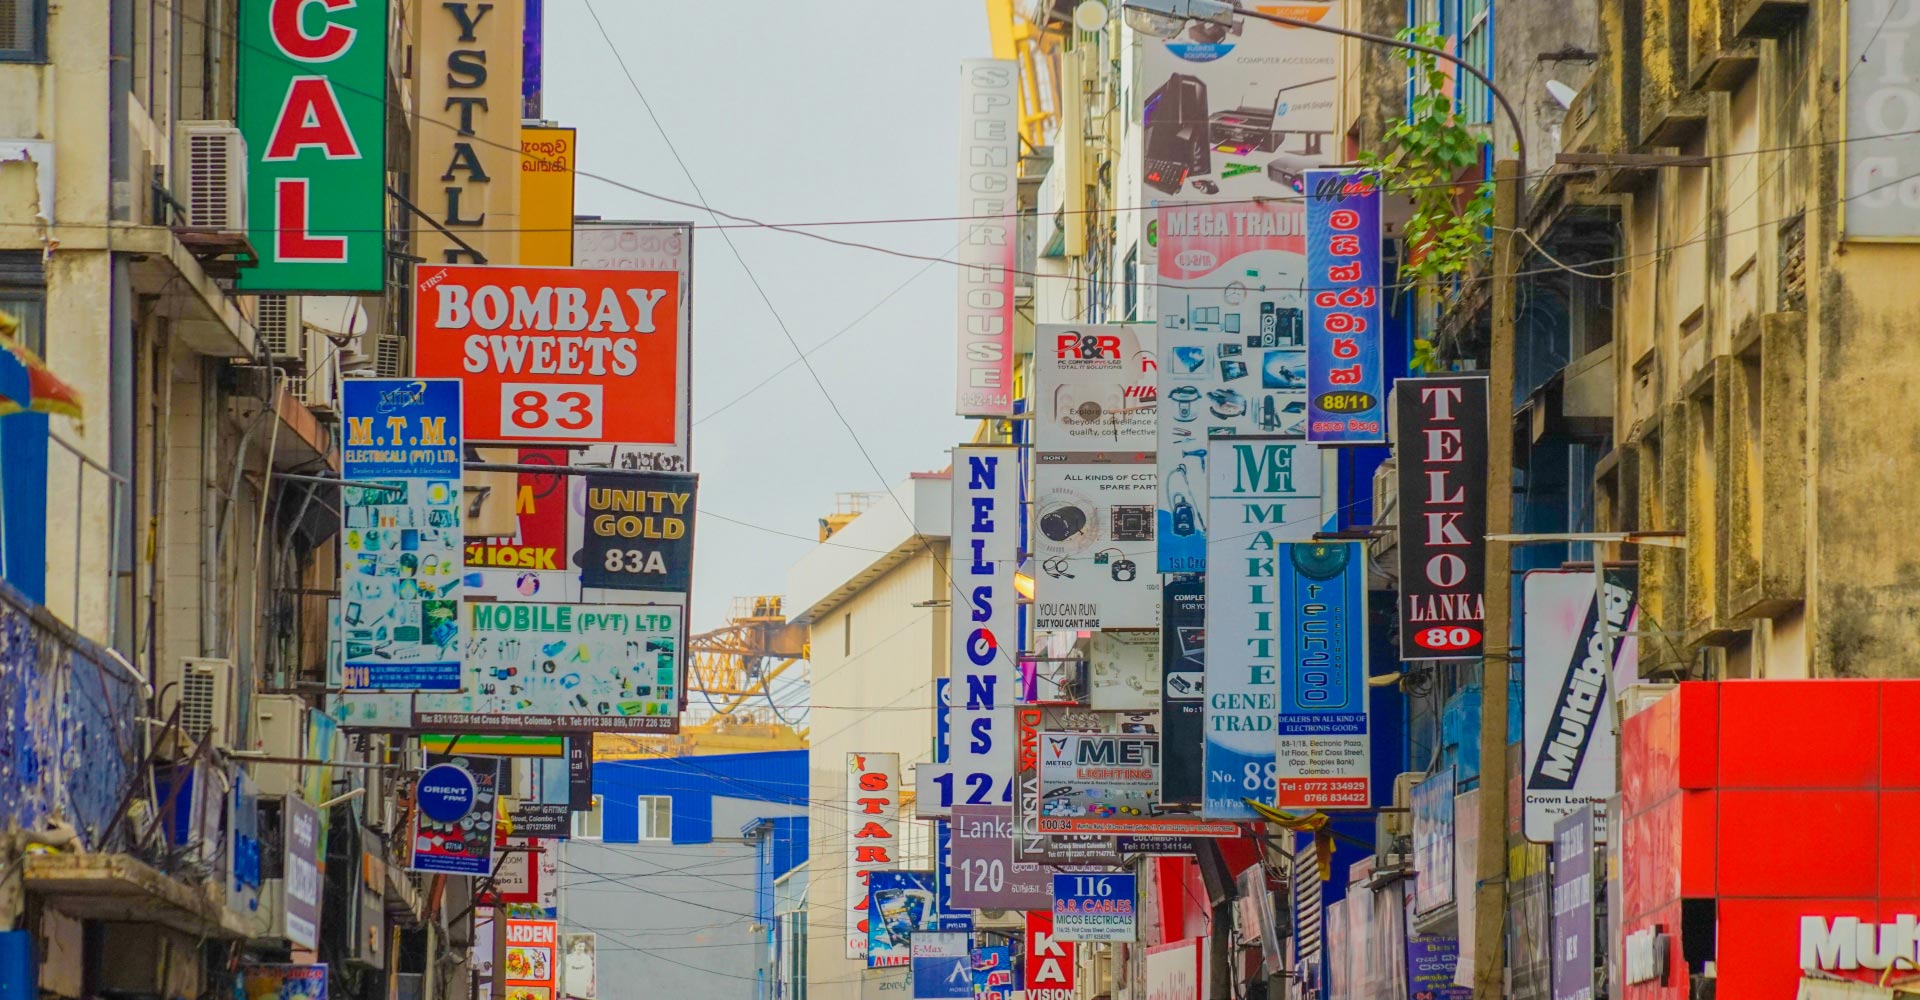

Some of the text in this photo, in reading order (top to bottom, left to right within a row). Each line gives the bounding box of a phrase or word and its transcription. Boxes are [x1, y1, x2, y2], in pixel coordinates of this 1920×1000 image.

[1281, 57, 1334, 65] ACCESSORIES
[970, 66, 1010, 245] SPENCER
[1167, 212, 1230, 238] MEGA
[420, 268, 448, 292] FIRST
[435, 285, 666, 333] BOMBAY
[966, 263, 1005, 388] HOUSE
[1056, 334, 1121, 360] R&R
[463, 334, 637, 377] SWEETS
[511, 391, 594, 430] 83
[1323, 395, 1369, 410] 88/11
[1070, 408, 1100, 416] Explore
[347, 416, 457, 446] M.T.M.
[1070, 419, 1100, 428] beyond
[1070, 429, 1156, 438] quality, effective
[345, 449, 459, 465] ELECTRICALS (PVT) LTD.
[1421, 387, 1471, 588] TELKO
[588, 488, 690, 515] UNITY
[593, 514, 685, 540] GOLD
[604, 549, 667, 575] 83A
[1169, 557, 1185, 568] 1st
[967, 457, 998, 755] NELSONS
[1039, 604, 1097, 616] YOU CAN RUN
[1410, 594, 1484, 622] LANKA
[473, 605, 672, 635] MOBILE (PVT) LTD
[1037, 619, 1100, 628] BUT YOU CAN'T HIDE
[1426, 629, 1471, 647] 80
[470, 715, 480, 724] 1st
[481, 715, 500, 724] Cross
[501, 715, 523, 726] Street,
[524, 716, 552, 725] Colombo
[583, 717, 599, 727] 0112
[628, 718, 644, 728] 0777
[1309, 759, 1335, 767] Peoples
[1077, 768, 1153, 780] LIGHTING
[1211, 762, 1277, 791] No. 88
[424, 786, 468, 794] ORIENT
[1281, 782, 1364, 791] Tel 0772 334929
[1207, 798, 1245, 808] Tel/Fax
[1304, 793, 1365, 802] 0766 834422
[1526, 795, 1561, 804] Crown
[1041, 820, 1071, 829] 100/34
[960, 858, 1003, 892] 120
[1074, 877, 1112, 897] 116
[1056, 899, 1131, 913] S.R. CABLES
[1056, 915, 1133, 925] MICOS ELECTRICALS
[1027, 988, 1074, 1000] VISION
